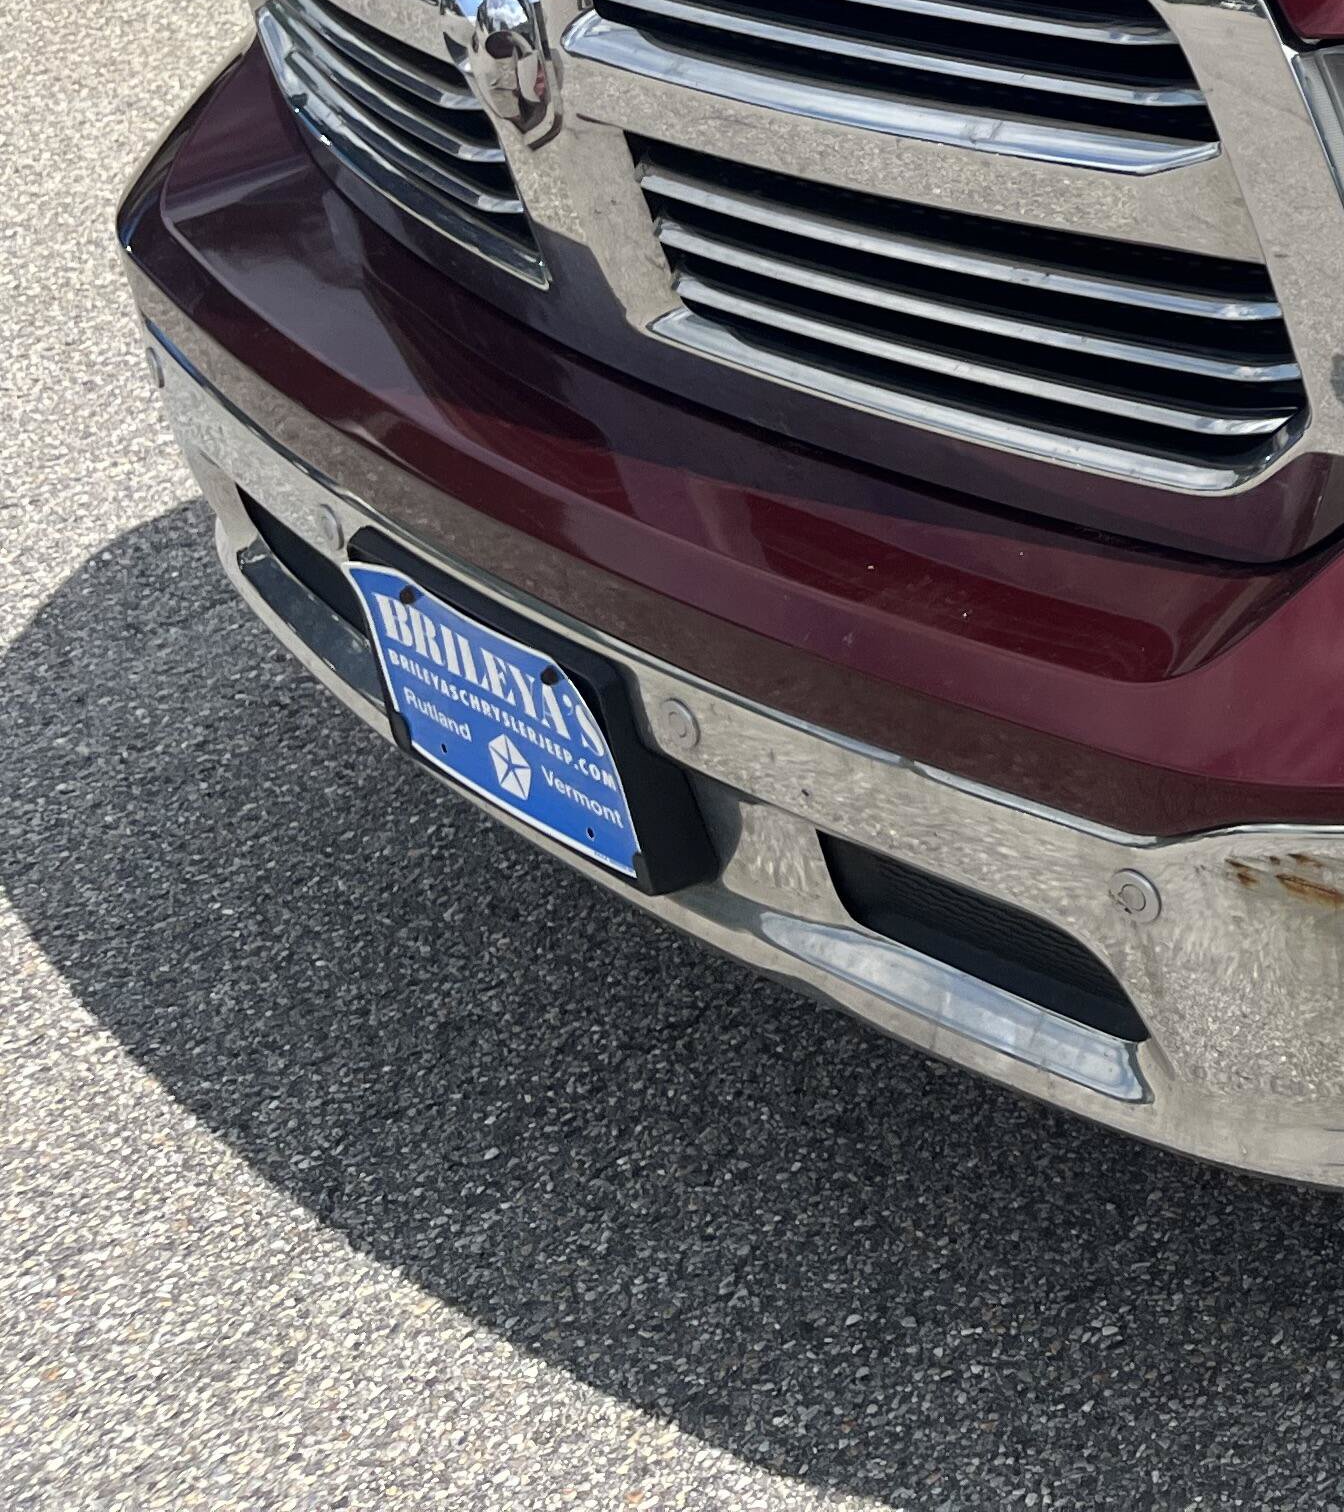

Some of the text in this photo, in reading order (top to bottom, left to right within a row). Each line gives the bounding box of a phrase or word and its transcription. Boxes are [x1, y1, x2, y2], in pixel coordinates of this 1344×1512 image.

[374, 591, 606, 758] BRILEYA'S
[403, 685, 472, 743] Rutland
[540, 763, 626, 830] Vermont
